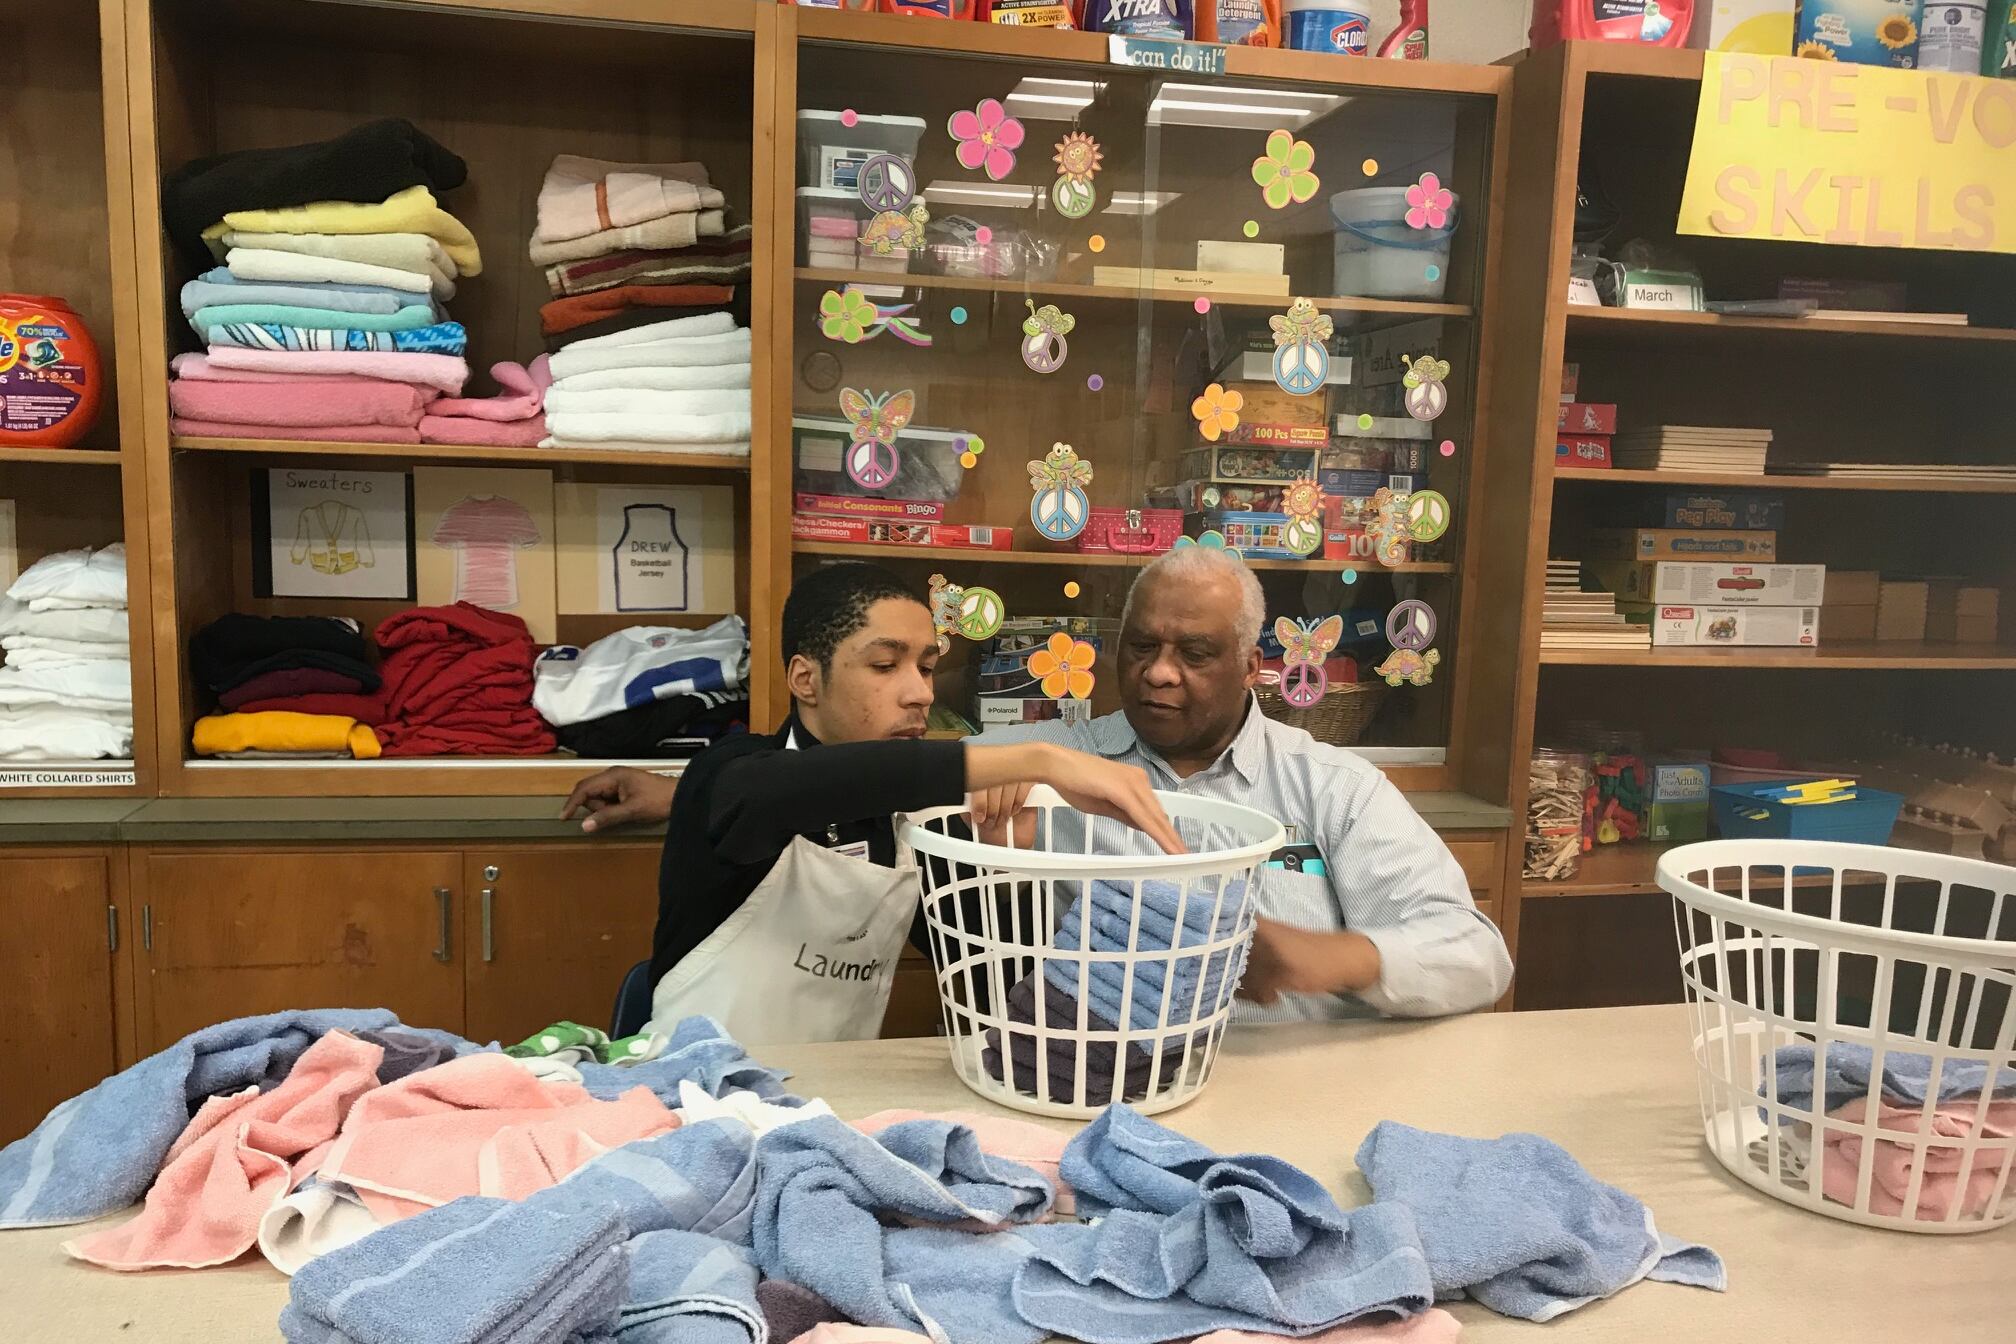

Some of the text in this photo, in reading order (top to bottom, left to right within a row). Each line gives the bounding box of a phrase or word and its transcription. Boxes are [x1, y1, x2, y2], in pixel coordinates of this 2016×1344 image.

[1102, 0, 1161, 23] XTRA
[1223, 0, 1258, 11] Laundry
[1022, 13, 1037, 24] 2X
[1038, 15, 1065, 23] POWER
[1218, 8, 1262, 21] Detergent
[1132, 49, 1166, 68] can
[1171, 46, 1193, 71] do
[1718, 54, 1859, 133] PRE
[1709, 164, 1995, 250] SKILLS
[1634, 289, 1673, 302] March
[21, 327, 42, 336] 70%
[1255, 427, 1273, 439] 100
[1275, 428, 1289, 440] Pcs
[1410, 450, 1418, 469] 1000
[286, 471, 373, 494] Sweaters
[817, 500, 937, 516] Initial Consonants Bingo
[791, 516, 866, 530] hess/Checkers/
[1676, 508, 1704, 527] Peg
[1706, 508, 1737, 528] Play
[631, 541, 672, 553] DREW
[1348, 534, 1378, 557] 10
[630, 559, 672, 567] Basketball
[638, 570, 664, 579] Jersey
[992, 706, 1018, 714] Polaroid
[0, 774, 134, 784] WHITE COLLARED SHIRTS
[1661, 770, 1676, 780] Just
[1676, 775, 1704, 786] Adults
[1660, 788, 1681, 797] Photo
